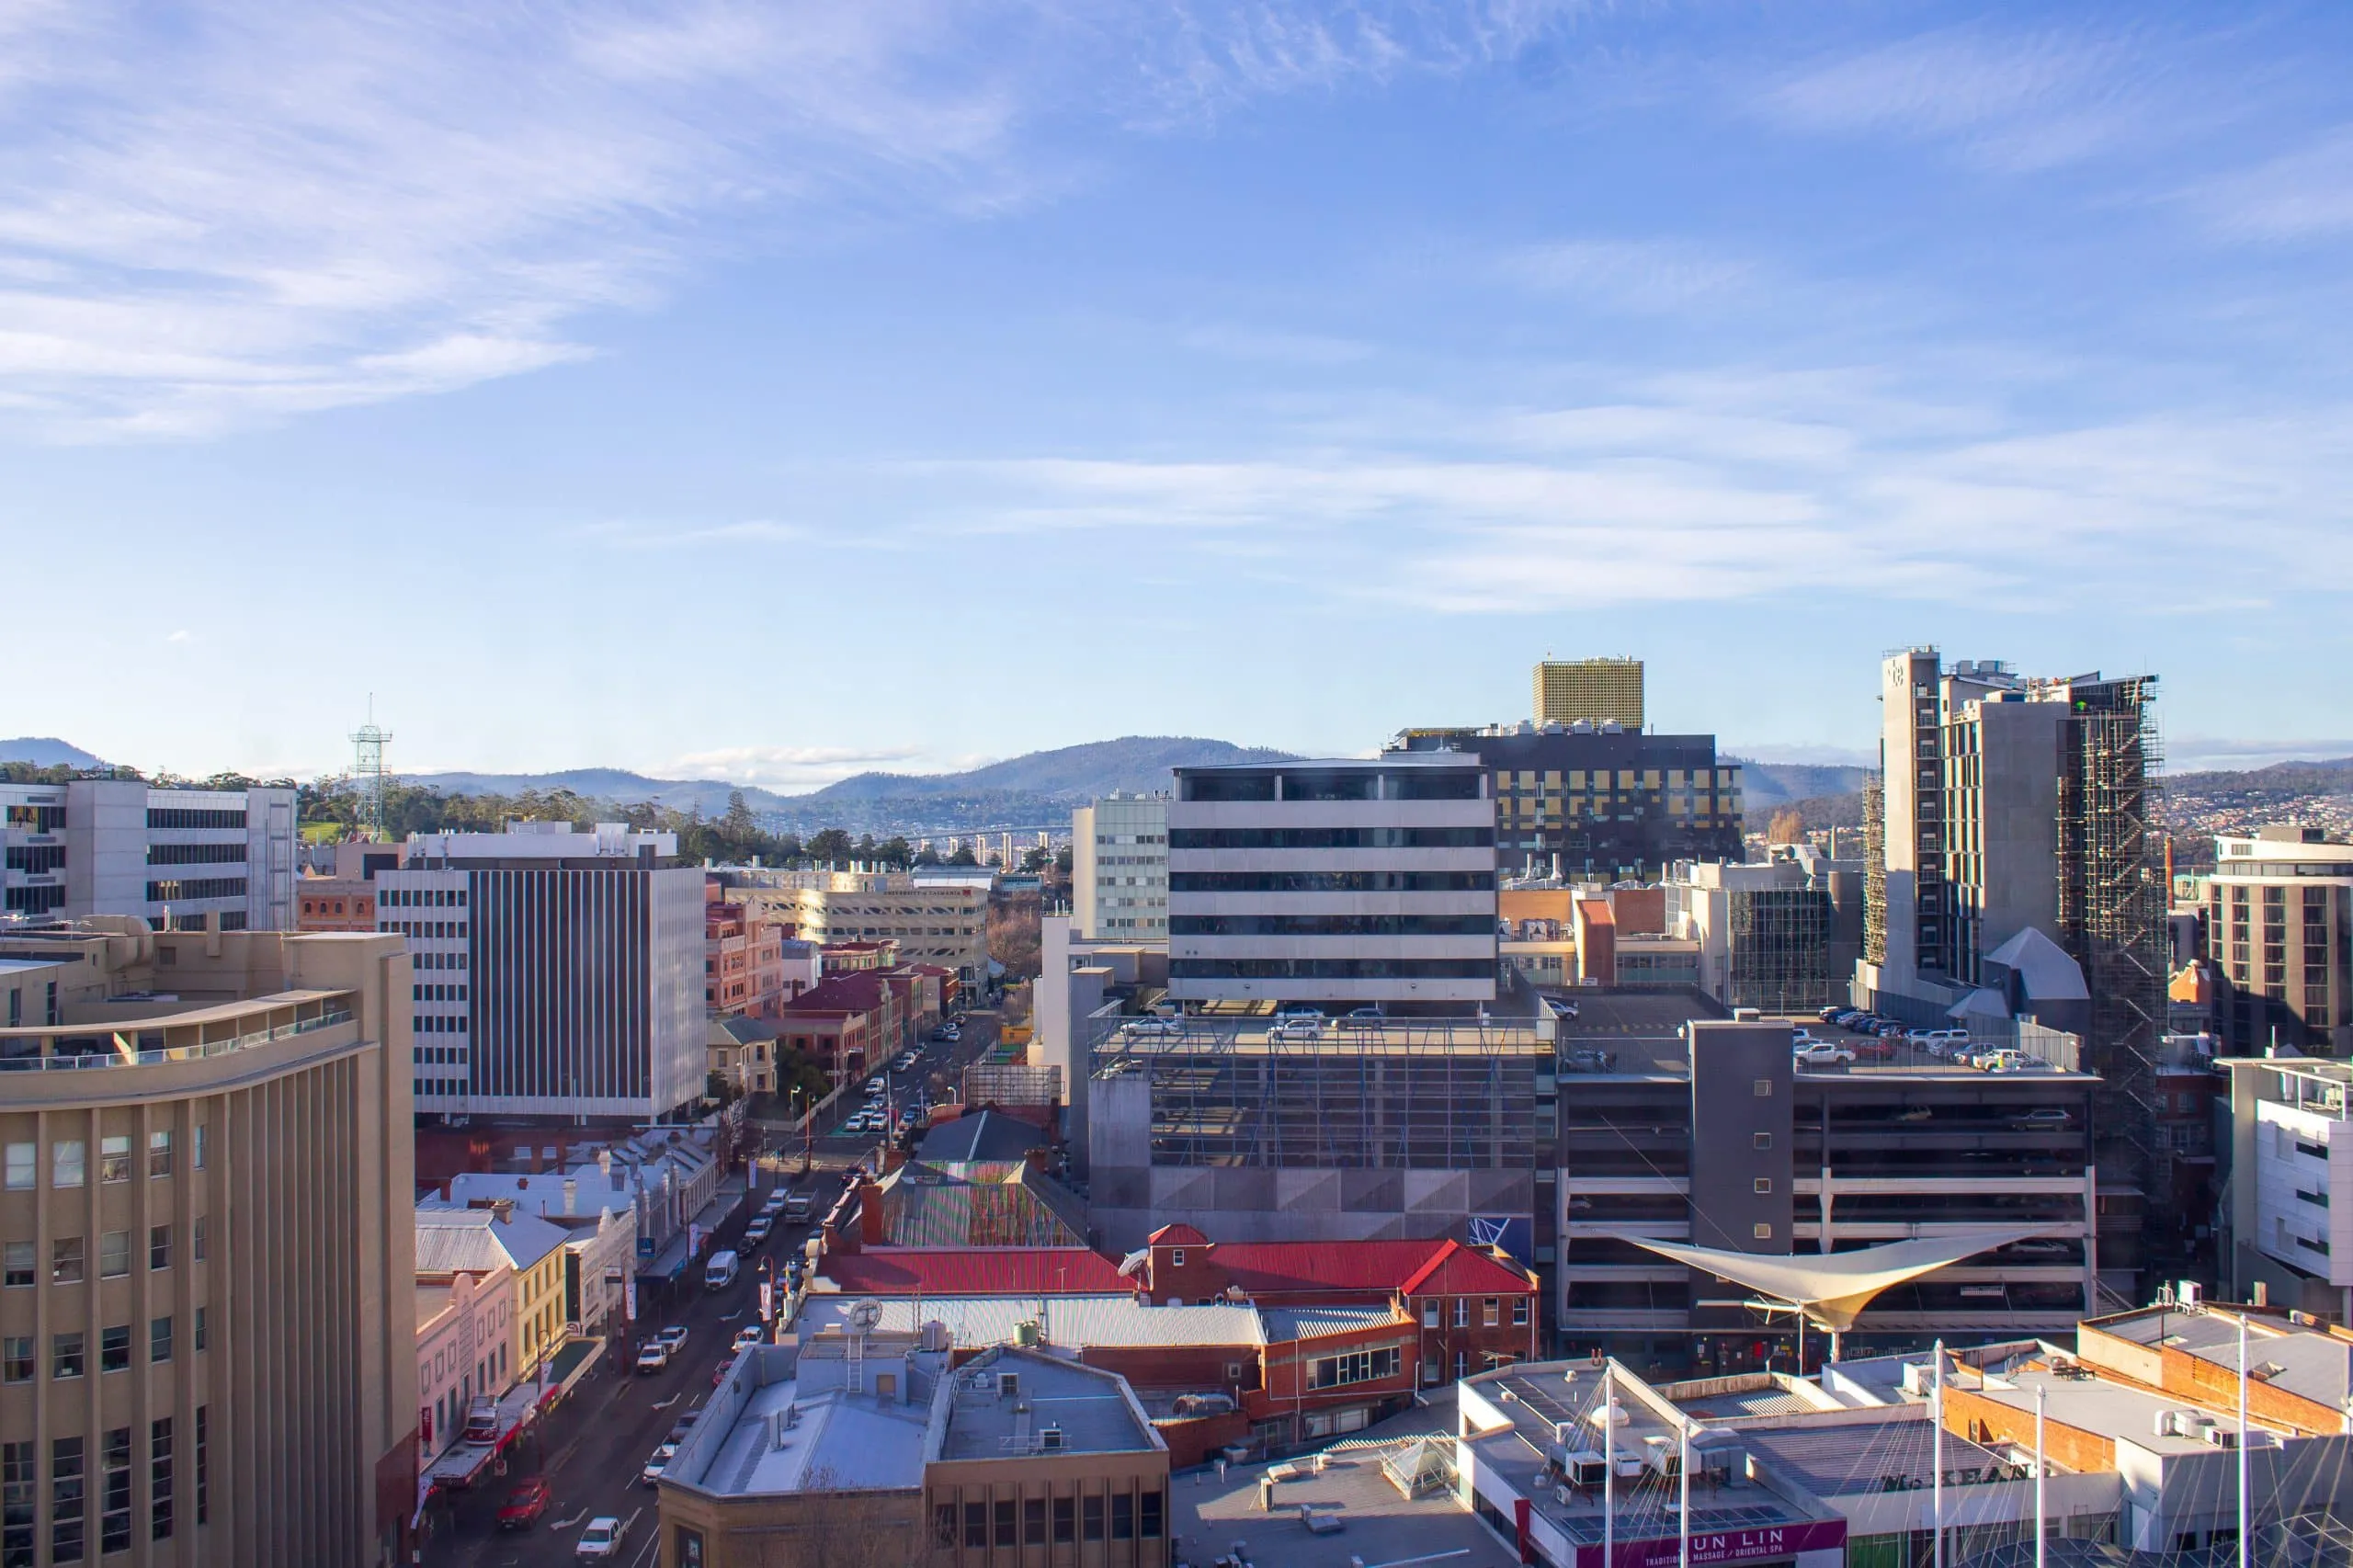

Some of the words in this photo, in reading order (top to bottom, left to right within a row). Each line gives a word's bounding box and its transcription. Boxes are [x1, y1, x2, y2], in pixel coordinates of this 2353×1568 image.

[1679, 1535, 1726, 1552] UN
[1743, 1528, 1783, 1545] LIN
[1693, 1551, 1725, 1562] MASSAGE
[1735, 1545, 1768, 1558] ORIENTAL
[1770, 1544, 1783, 1553] SPA
